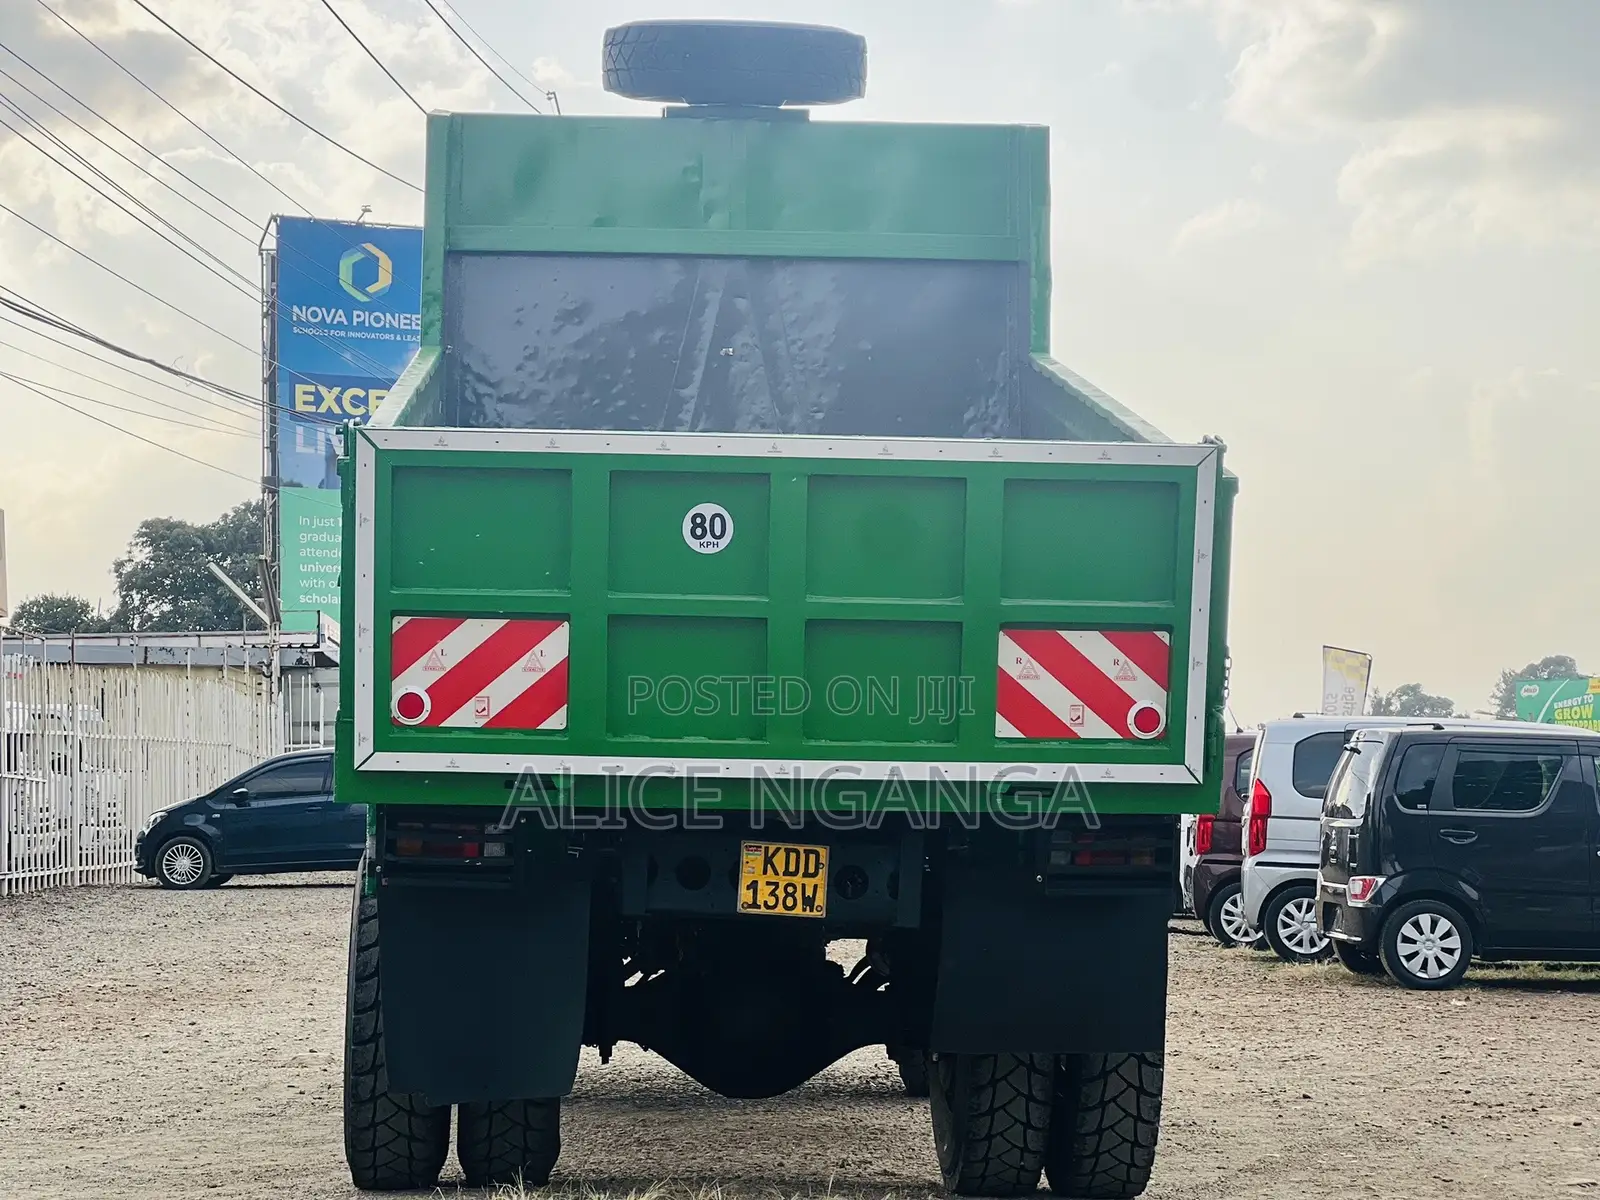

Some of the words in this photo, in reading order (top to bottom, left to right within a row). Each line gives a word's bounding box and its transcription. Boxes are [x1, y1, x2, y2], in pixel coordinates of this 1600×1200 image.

[292, 305, 348, 325] NOVA
[330, 329, 347, 337] FOR
[347, 331, 395, 341] INNOVATORS
[299, 516, 310, 526] In
[312, 516, 335, 528] just
[690, 512, 727, 541] 80
[699, 541, 719, 549] KPH
[299, 577, 325, 589] with
[1015, 657, 1023, 665] R
[1113, 658, 1120, 666] R
[1554, 697, 1581, 709] ENERGY
[1583, 694, 1594, 704] TO
[1554, 704, 1594, 720] GROW
[762, 845, 820, 878] KDD
[741, 880, 818, 913] 138W
